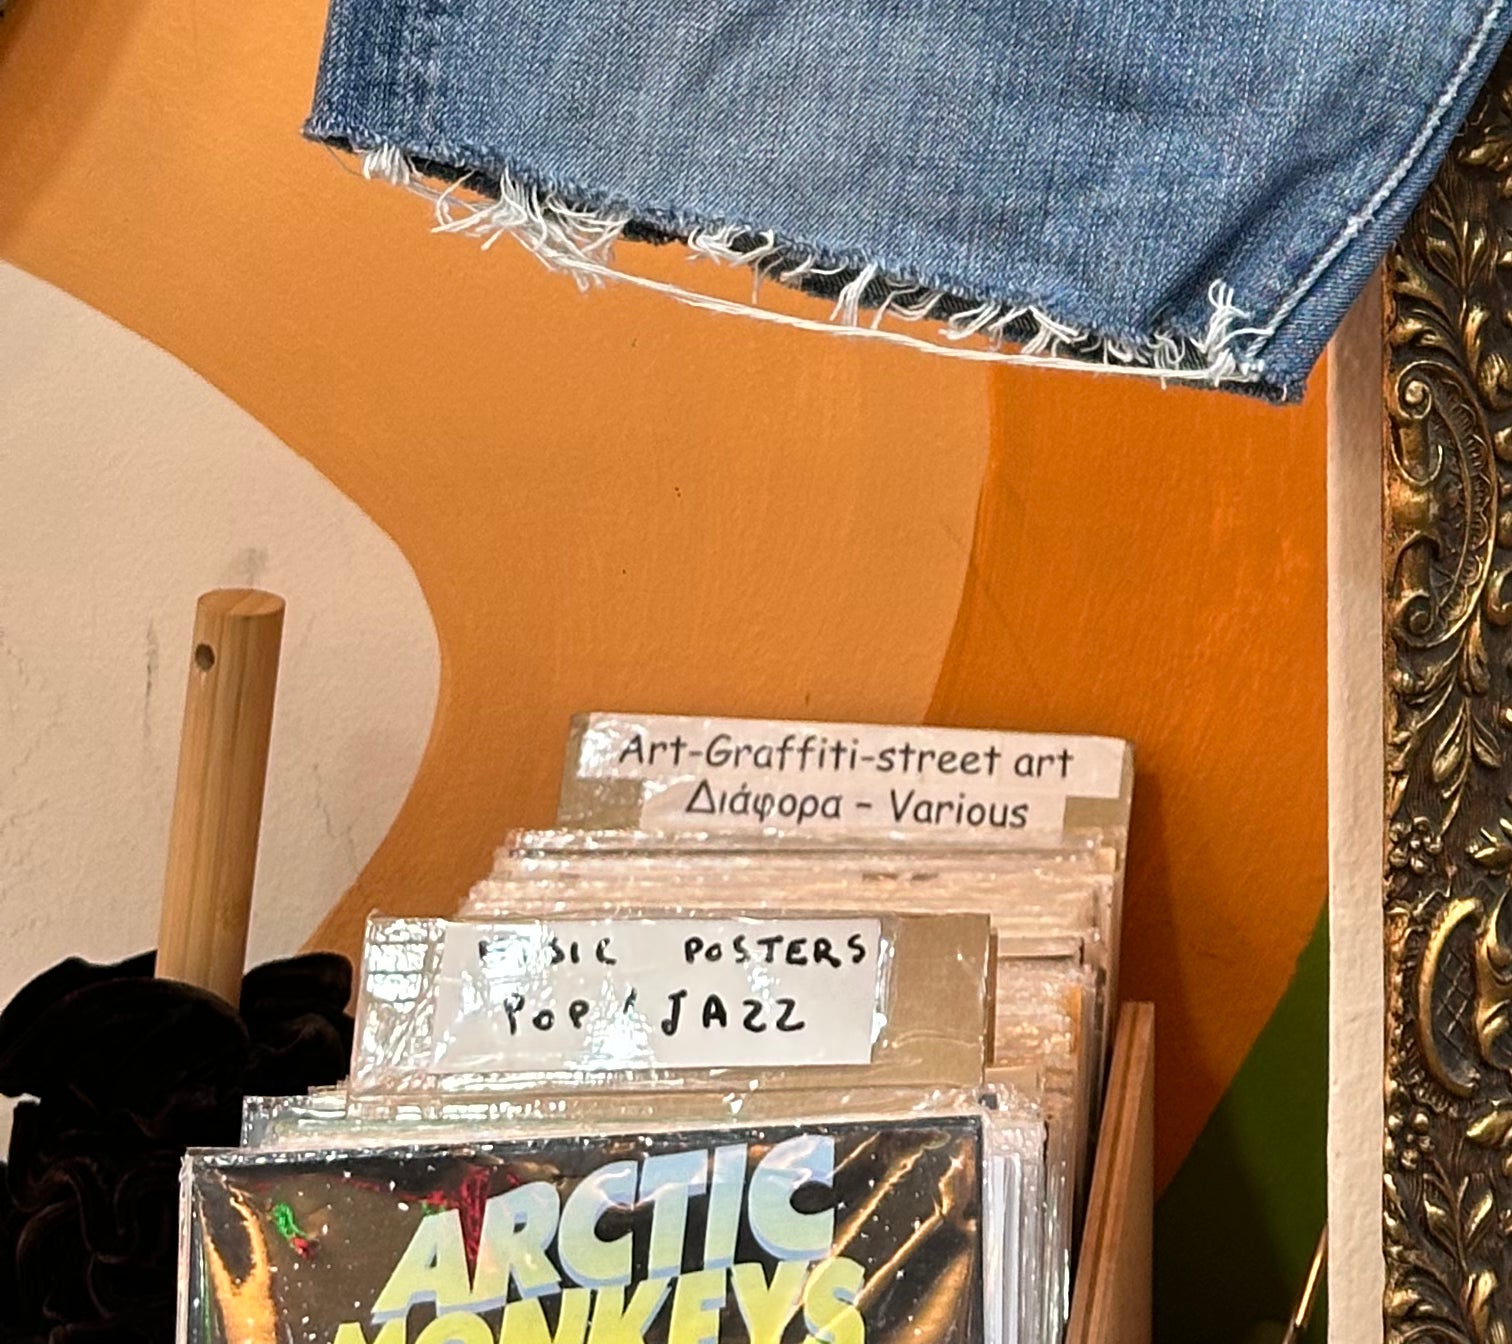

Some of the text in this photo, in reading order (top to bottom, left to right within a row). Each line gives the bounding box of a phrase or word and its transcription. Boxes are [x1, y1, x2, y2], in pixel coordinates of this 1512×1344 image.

[618, 732, 1075, 779] Art-Graffiti-street art
[684, 778, 843, 825] Διάφορα
[889, 787, 1030, 829] Various
[478, 933, 867, 969] SIC POSTERS
[503, 992, 590, 1036] POP
[660, 988, 806, 1037] JAZZ
[369, 1134, 837, 1325] ARCTIC
[332, 1255, 867, 1344] KEYS
